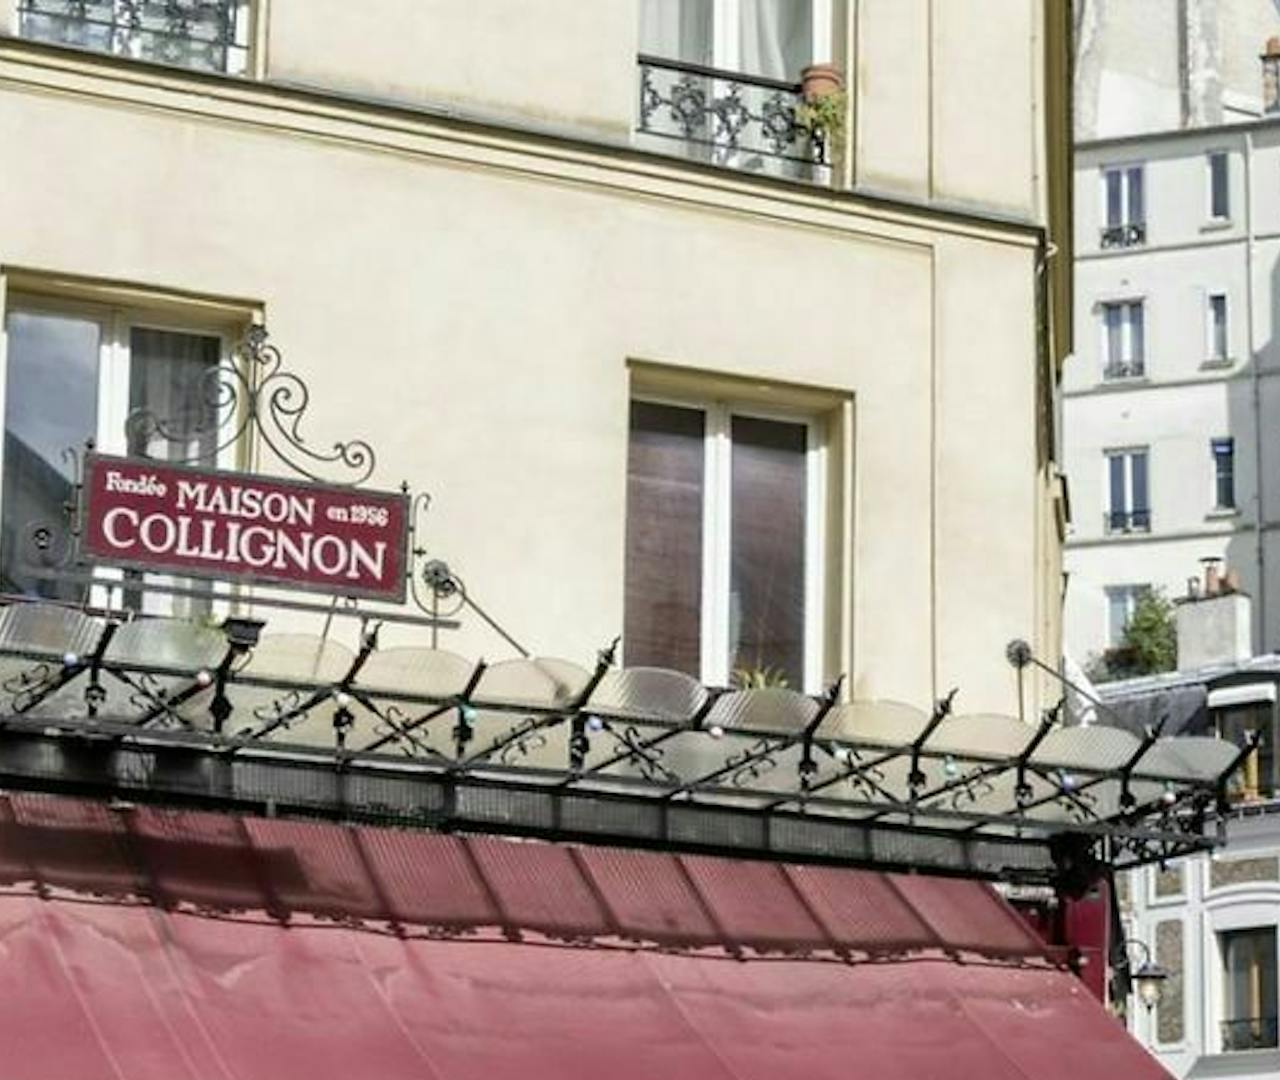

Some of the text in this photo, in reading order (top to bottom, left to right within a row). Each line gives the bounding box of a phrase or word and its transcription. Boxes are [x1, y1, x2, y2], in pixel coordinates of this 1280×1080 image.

[176, 480, 315, 526] MAISON
[326, 505, 349, 522] en
[102, 507, 387, 580] COLLIGNON
